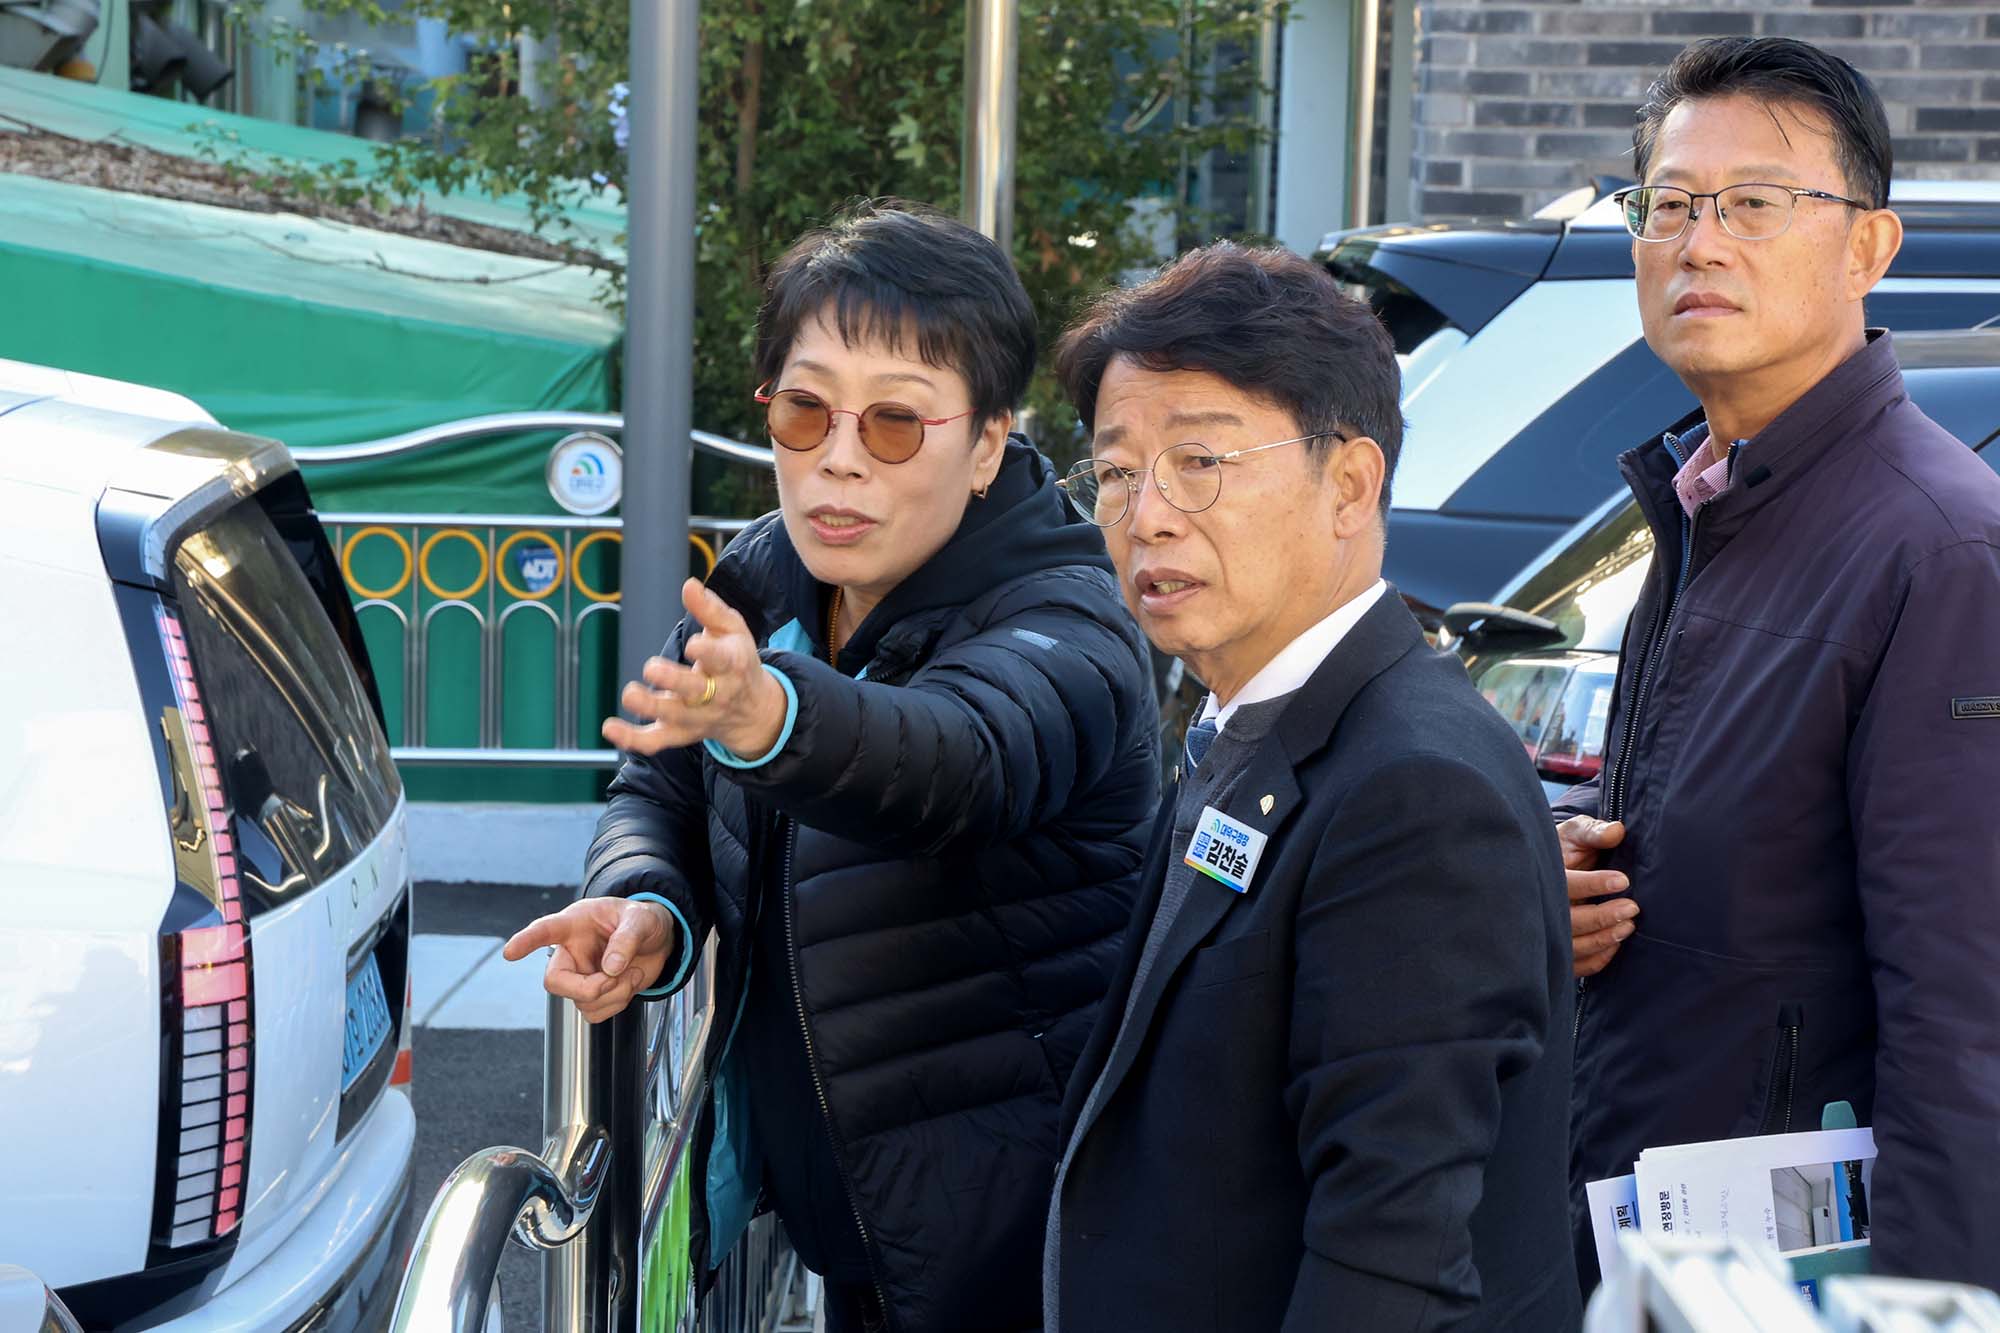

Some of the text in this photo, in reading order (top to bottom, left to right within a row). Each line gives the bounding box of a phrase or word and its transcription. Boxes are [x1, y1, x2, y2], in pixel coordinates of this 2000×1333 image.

[1220, 824, 1250, 847] 대덕구청장
[1205, 838, 1249, 880] 김찬술
[1616, 1204, 1632, 1230] 계획
[1659, 1190, 1673, 1232] 현장방문
